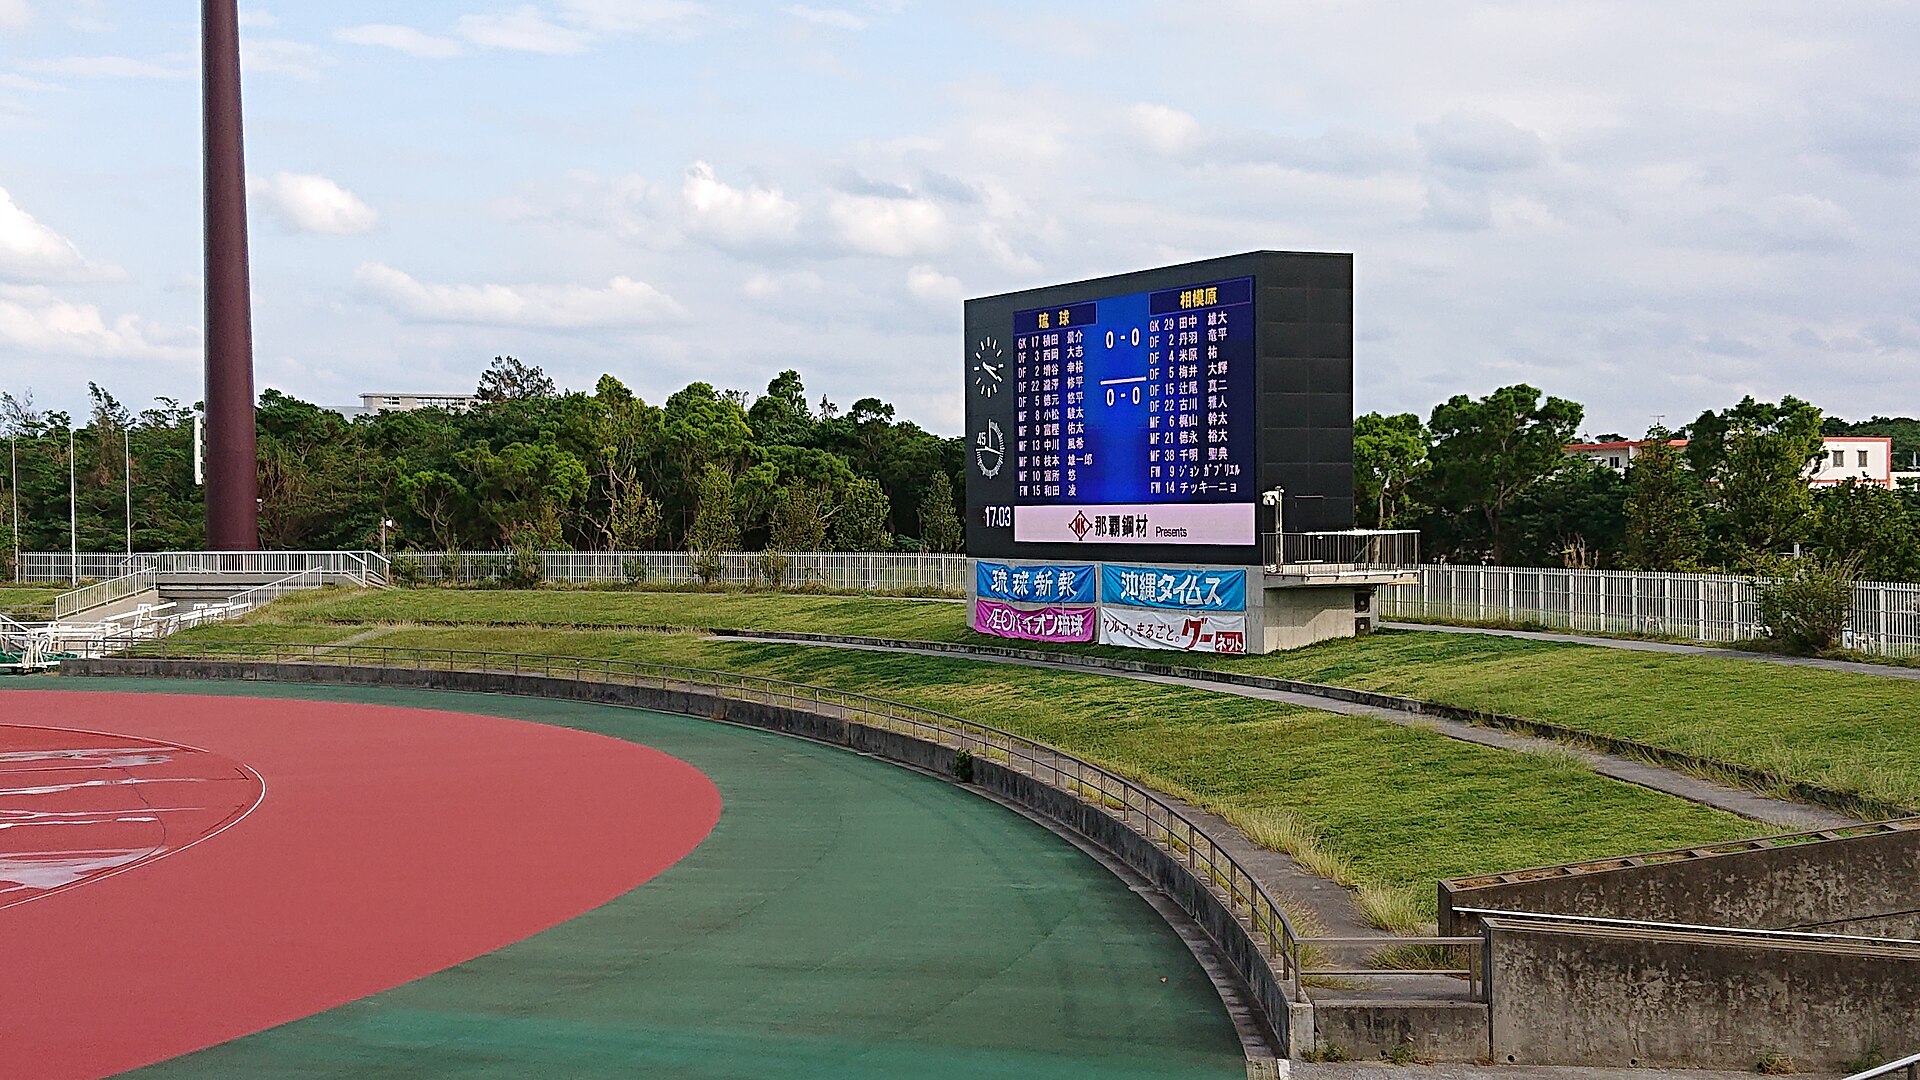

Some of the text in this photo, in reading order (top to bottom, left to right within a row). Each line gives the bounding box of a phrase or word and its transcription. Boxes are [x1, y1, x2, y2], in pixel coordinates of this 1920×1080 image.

[1180, 287, 1217, 309] 相模原
[1150, 320, 1160, 332] GK
[1164, 318, 1174, 330] 29
[1179, 315, 1197, 329] 田中
[1018, 338, 1026, 349] GK
[1032, 336, 1039, 348] 17
[1150, 328, 1227, 348] DF 2 丹羽 竜平
[1018, 345, 1083, 363] DF 3 西岡 大志
[1150, 352, 1160, 364] DF
[1169, 350, 1174, 362] 4
[1179, 348, 1198, 362] 米原
[1018, 367, 1026, 378] DF
[1034, 366, 1040, 377] 2
[1150, 361, 1228, 380] DF 5 梅井 大輝
[1019, 382, 1026, 392] DF
[1031, 380, 1039, 391] 22
[1067, 376, 1083, 389] 修平
[1150, 379, 1227, 396] DF 15 辻尾 真二
[1019, 397, 1027, 407] DF
[1035, 396, 1040, 406] 5
[1150, 395, 1227, 412] DF 22 古川 雅人
[1019, 411, 1027, 422] MF
[1035, 410, 1040, 421] 8
[1044, 409, 1059, 421] 小松
[1150, 416, 1160, 428] MF
[1169, 415, 1174, 427] 6
[1208, 412, 1227, 426] 幹太
[977, 432, 986, 445] 45
[1019, 425, 1027, 436] MF
[1035, 425, 1040, 435] 9
[1150, 432, 1160, 444] MF
[1164, 432, 1174, 444] 21
[1208, 428, 1227, 442] 裕大
[1019, 440, 1027, 451] MF
[1032, 440, 1040, 450] 13
[1044, 438, 1059, 451] 中川
[1019, 456, 1027, 467] MF
[1032, 456, 1040, 467] 16
[1044, 455, 1059, 467] 枝本
[1150, 447, 1228, 462] MF 38 千明 聖典
[1019, 471, 1027, 481] MF
[1032, 470, 1040, 481] 10
[1044, 470, 1060, 481] 富所
[1150, 466, 1160, 478] FW
[1170, 466, 1174, 477] 9
[1020, 486, 1028, 496] FW
[1032, 485, 1040, 496] 15
[1044, 485, 1060, 496] 和田
[1150, 482, 1160, 494] FW
[1166, 482, 1175, 494] 14
[1095, 514, 1148, 538] 那覇鋼材
[1155, 526, 1187, 537] Presents
[991, 569, 1077, 596] 琉球新報
[1121, 571, 1222, 606] 沖縄タイムス
